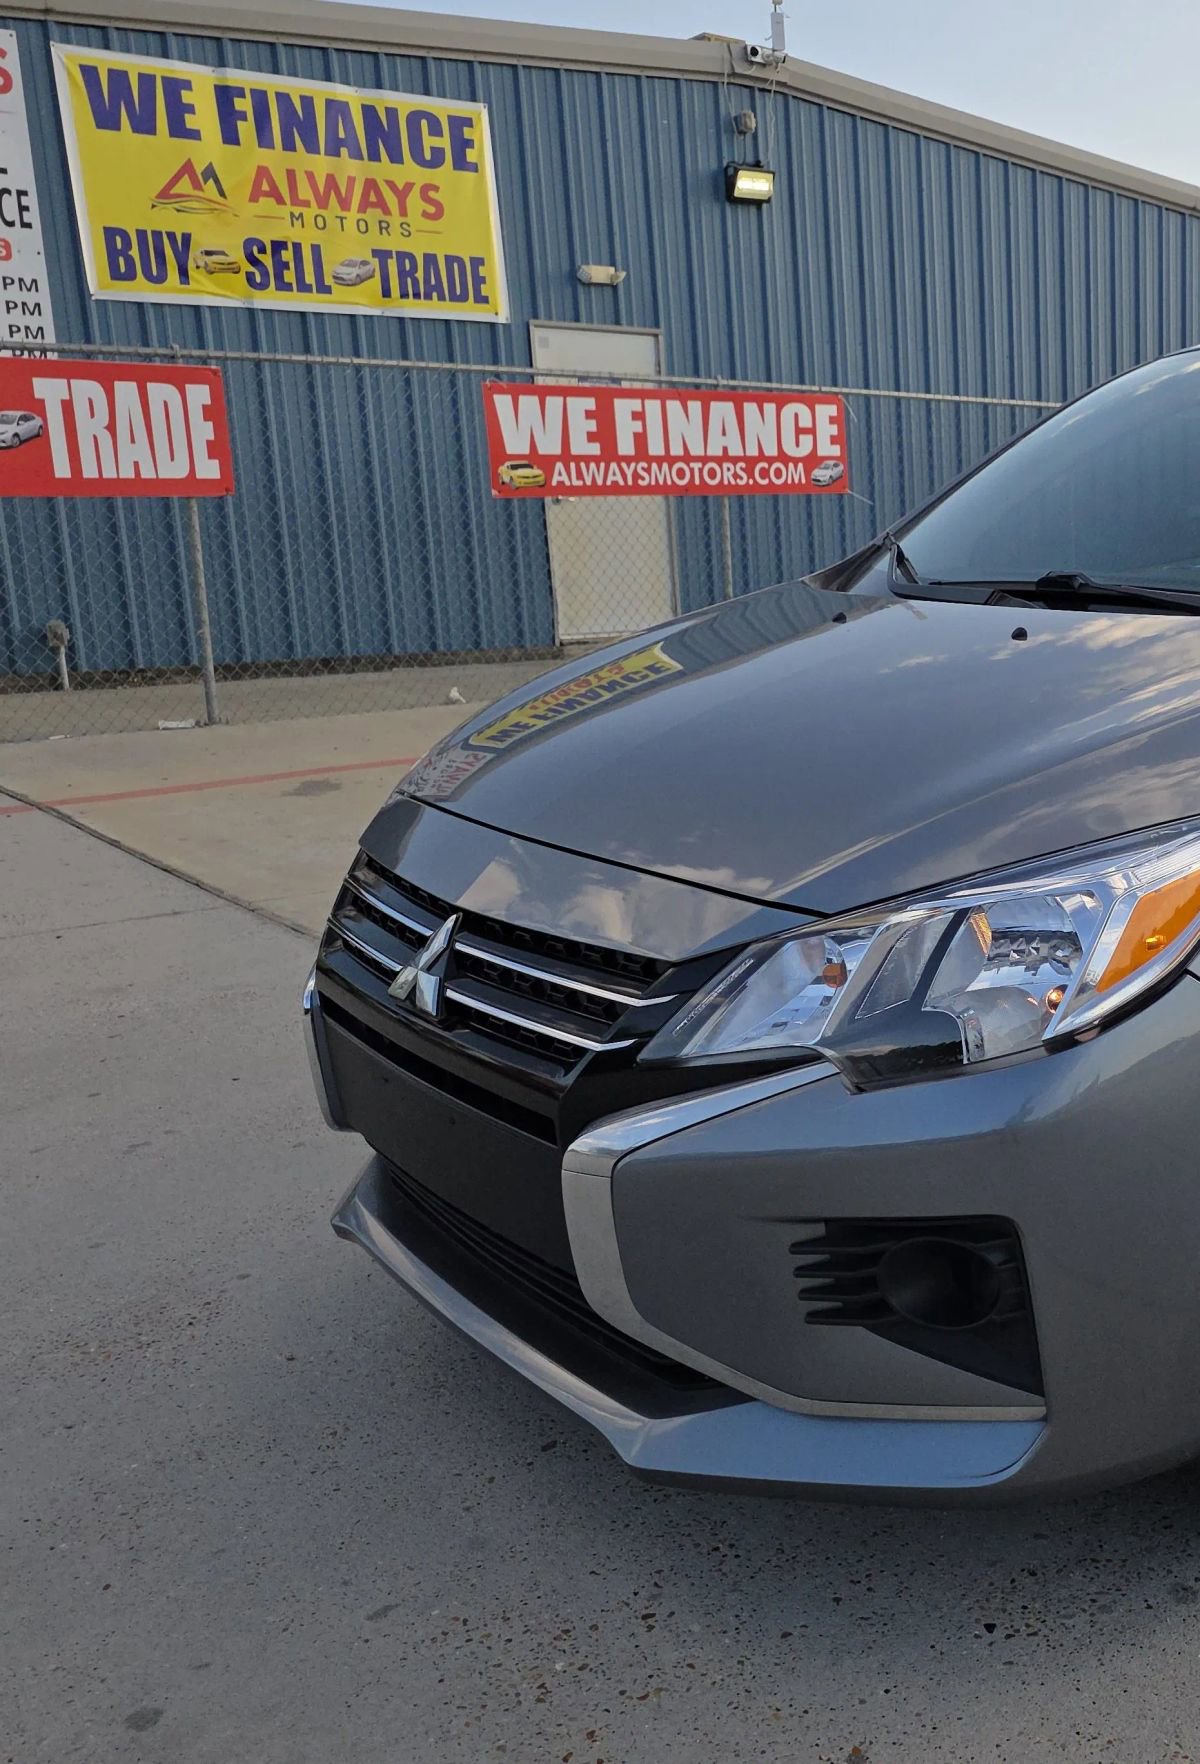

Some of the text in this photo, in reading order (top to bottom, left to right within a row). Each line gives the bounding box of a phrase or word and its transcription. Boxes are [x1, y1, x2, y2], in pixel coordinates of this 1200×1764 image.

[78, 64, 202, 142] WE
[213, 83, 479, 173] FINANCE
[248, 165, 445, 222] ALWAYS
[289, 211, 413, 238] MOTORS
[1, 275, 40, 293] PM
[102, 226, 490, 305] BUY SELL TRADE
[5, 299, 43, 317] PM
[8, 323, 46, 341] PM
[31, 376, 221, 480] TRADE
[493, 393, 842, 458] WE FINANCE
[551, 461, 806, 487] ALWAYSMOTORS.COM
